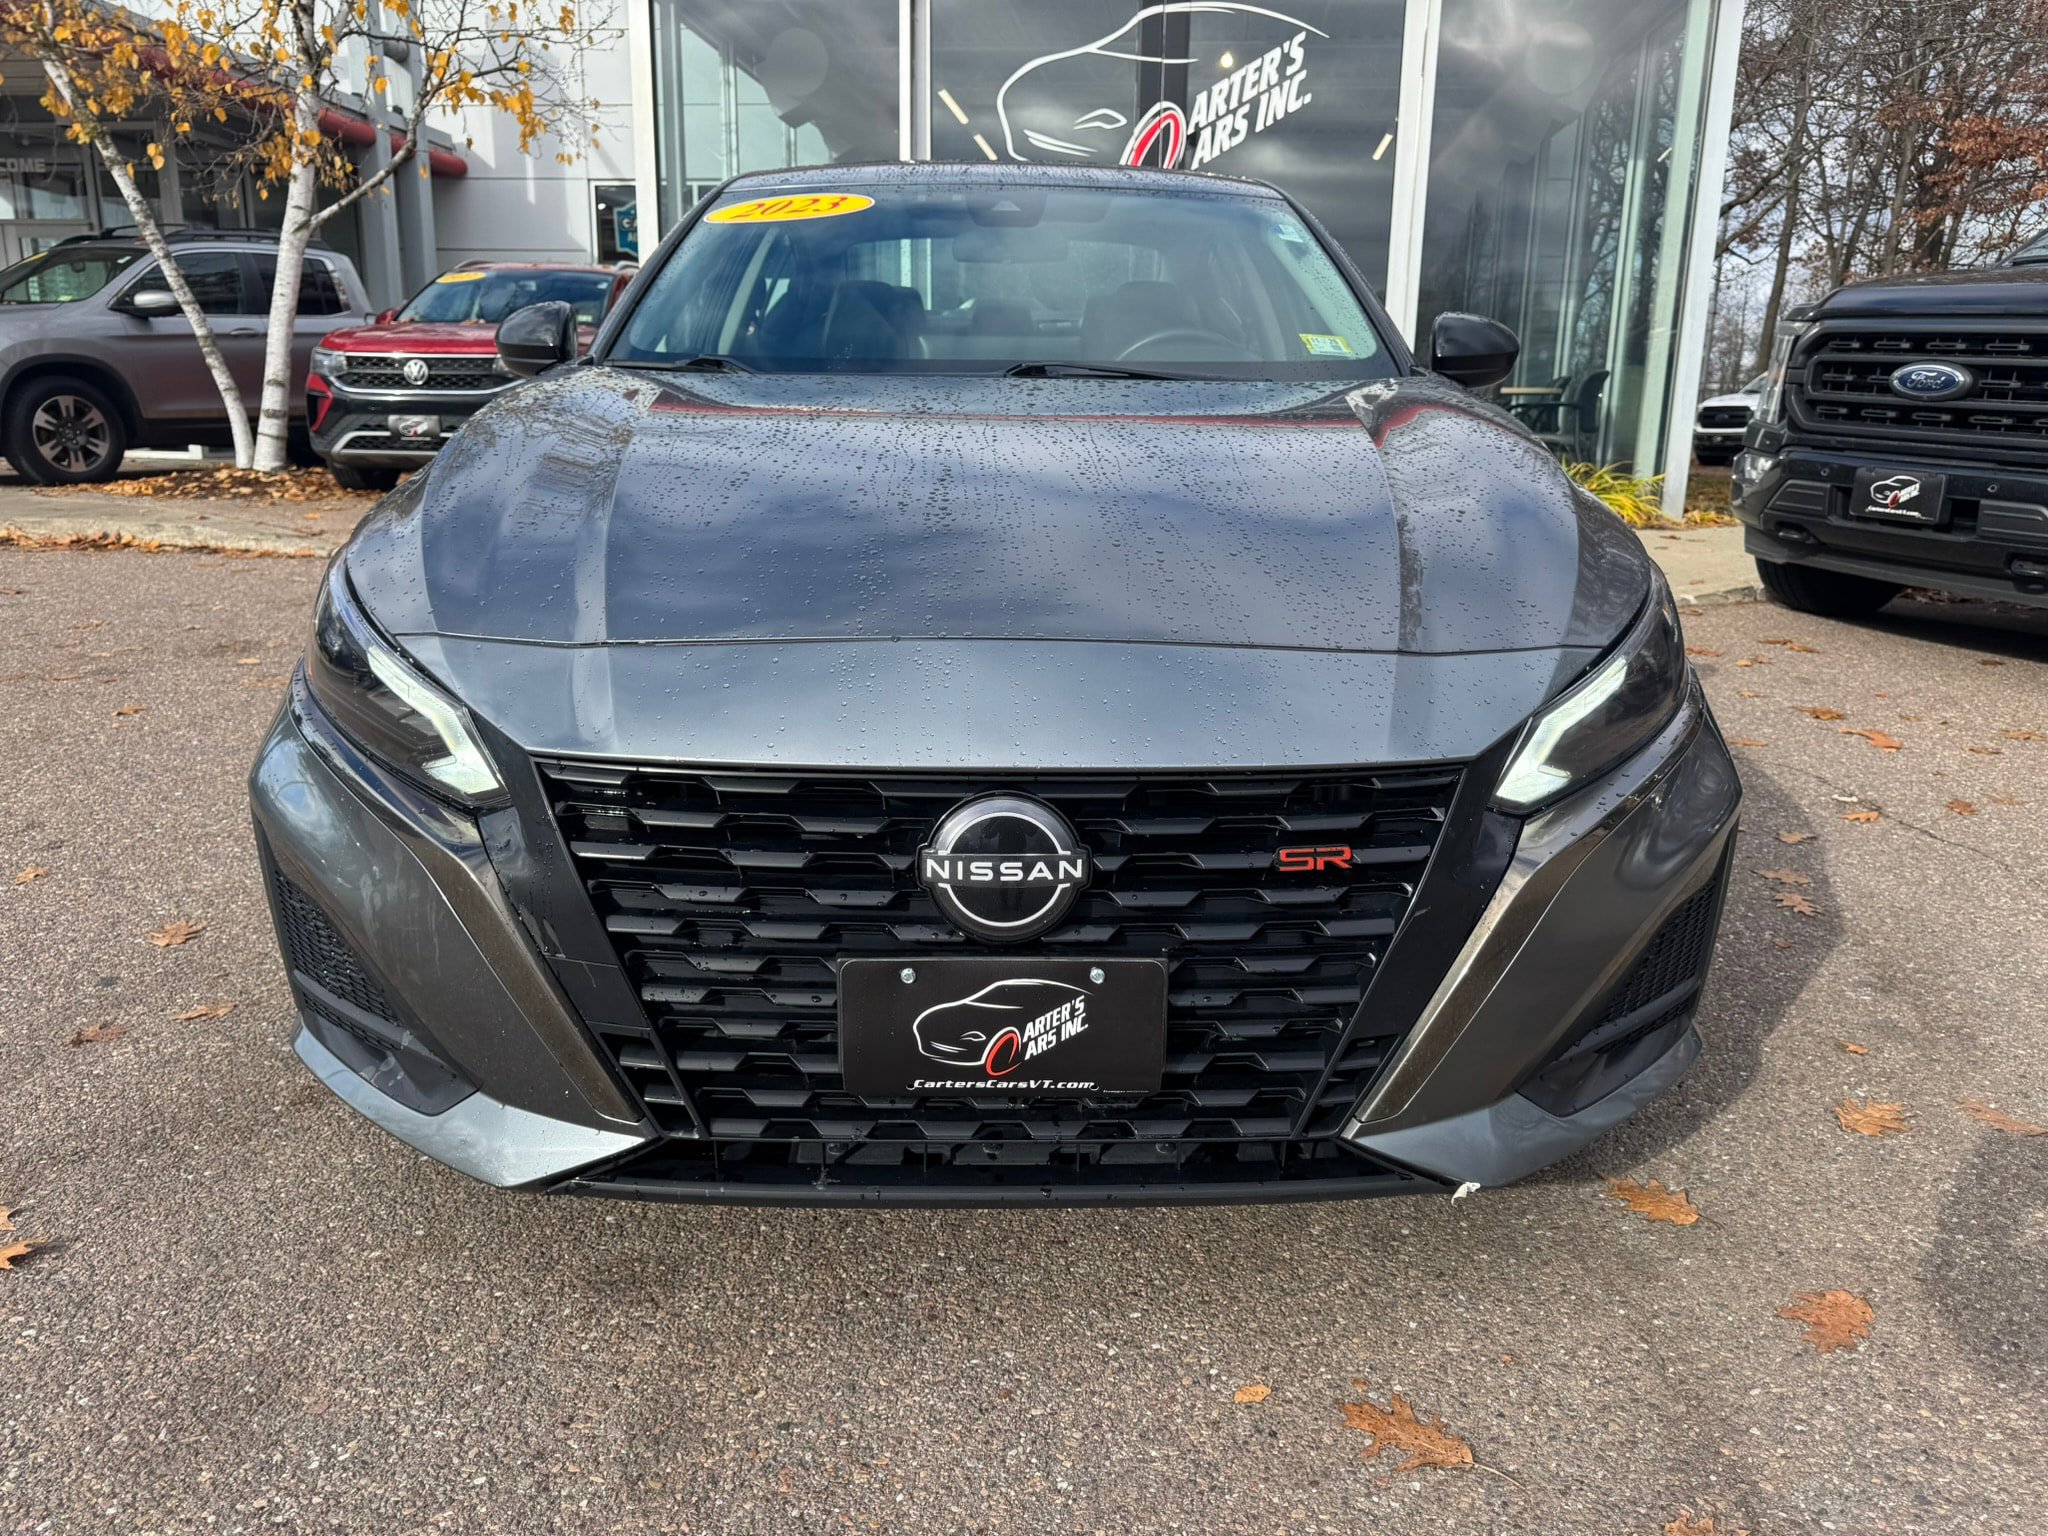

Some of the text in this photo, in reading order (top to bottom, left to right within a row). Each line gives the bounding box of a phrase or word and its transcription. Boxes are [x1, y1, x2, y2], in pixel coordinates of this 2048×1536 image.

[1255, 69, 1312, 133] INC.
[729, 196, 849, 219] 2023
[1906, 370, 1947, 389] Ford
[926, 858, 1083, 882] NISSAN
[1279, 846, 1352, 871] SR
[1061, 1012, 1090, 1042] INC.
[913, 1079, 1095, 1090] CartersCarsVT.com
